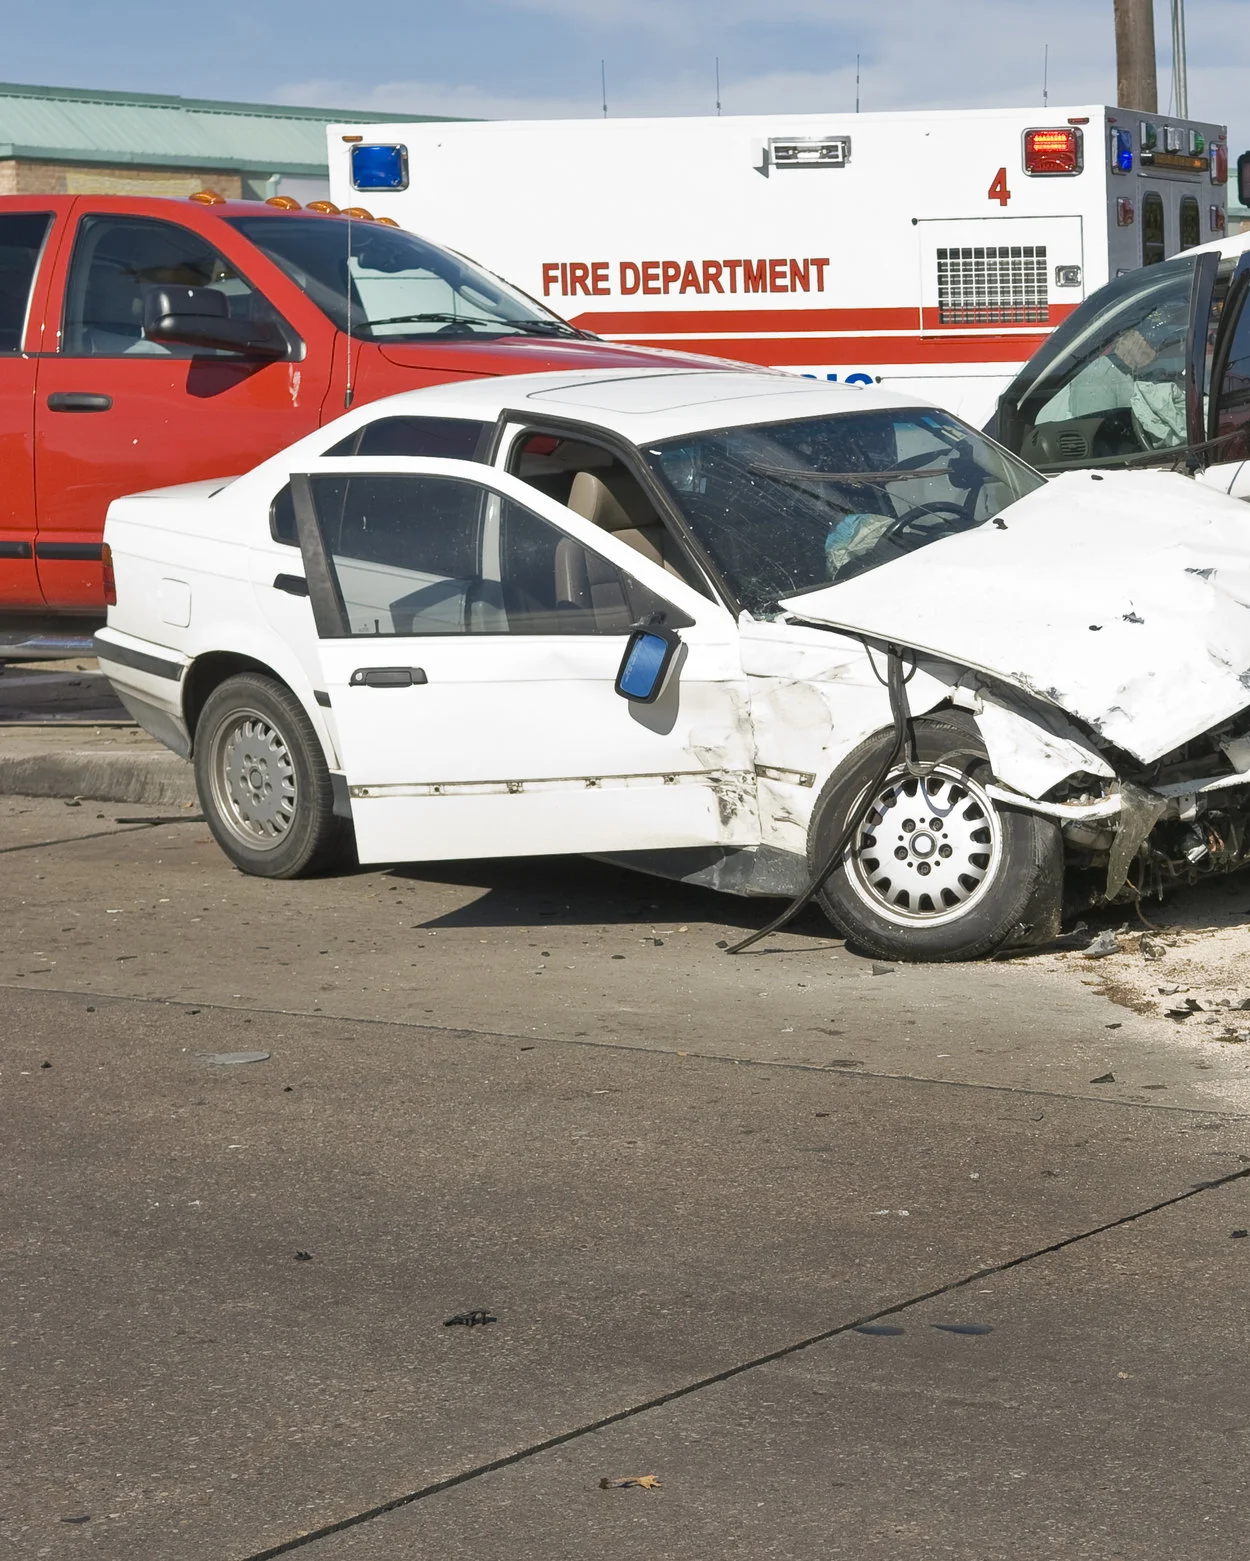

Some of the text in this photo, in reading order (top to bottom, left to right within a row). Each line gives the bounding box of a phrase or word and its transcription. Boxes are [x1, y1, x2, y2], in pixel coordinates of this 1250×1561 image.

[988, 167, 1011, 206] 4
[542, 258, 829, 296] FIRE DEPARTMENT
